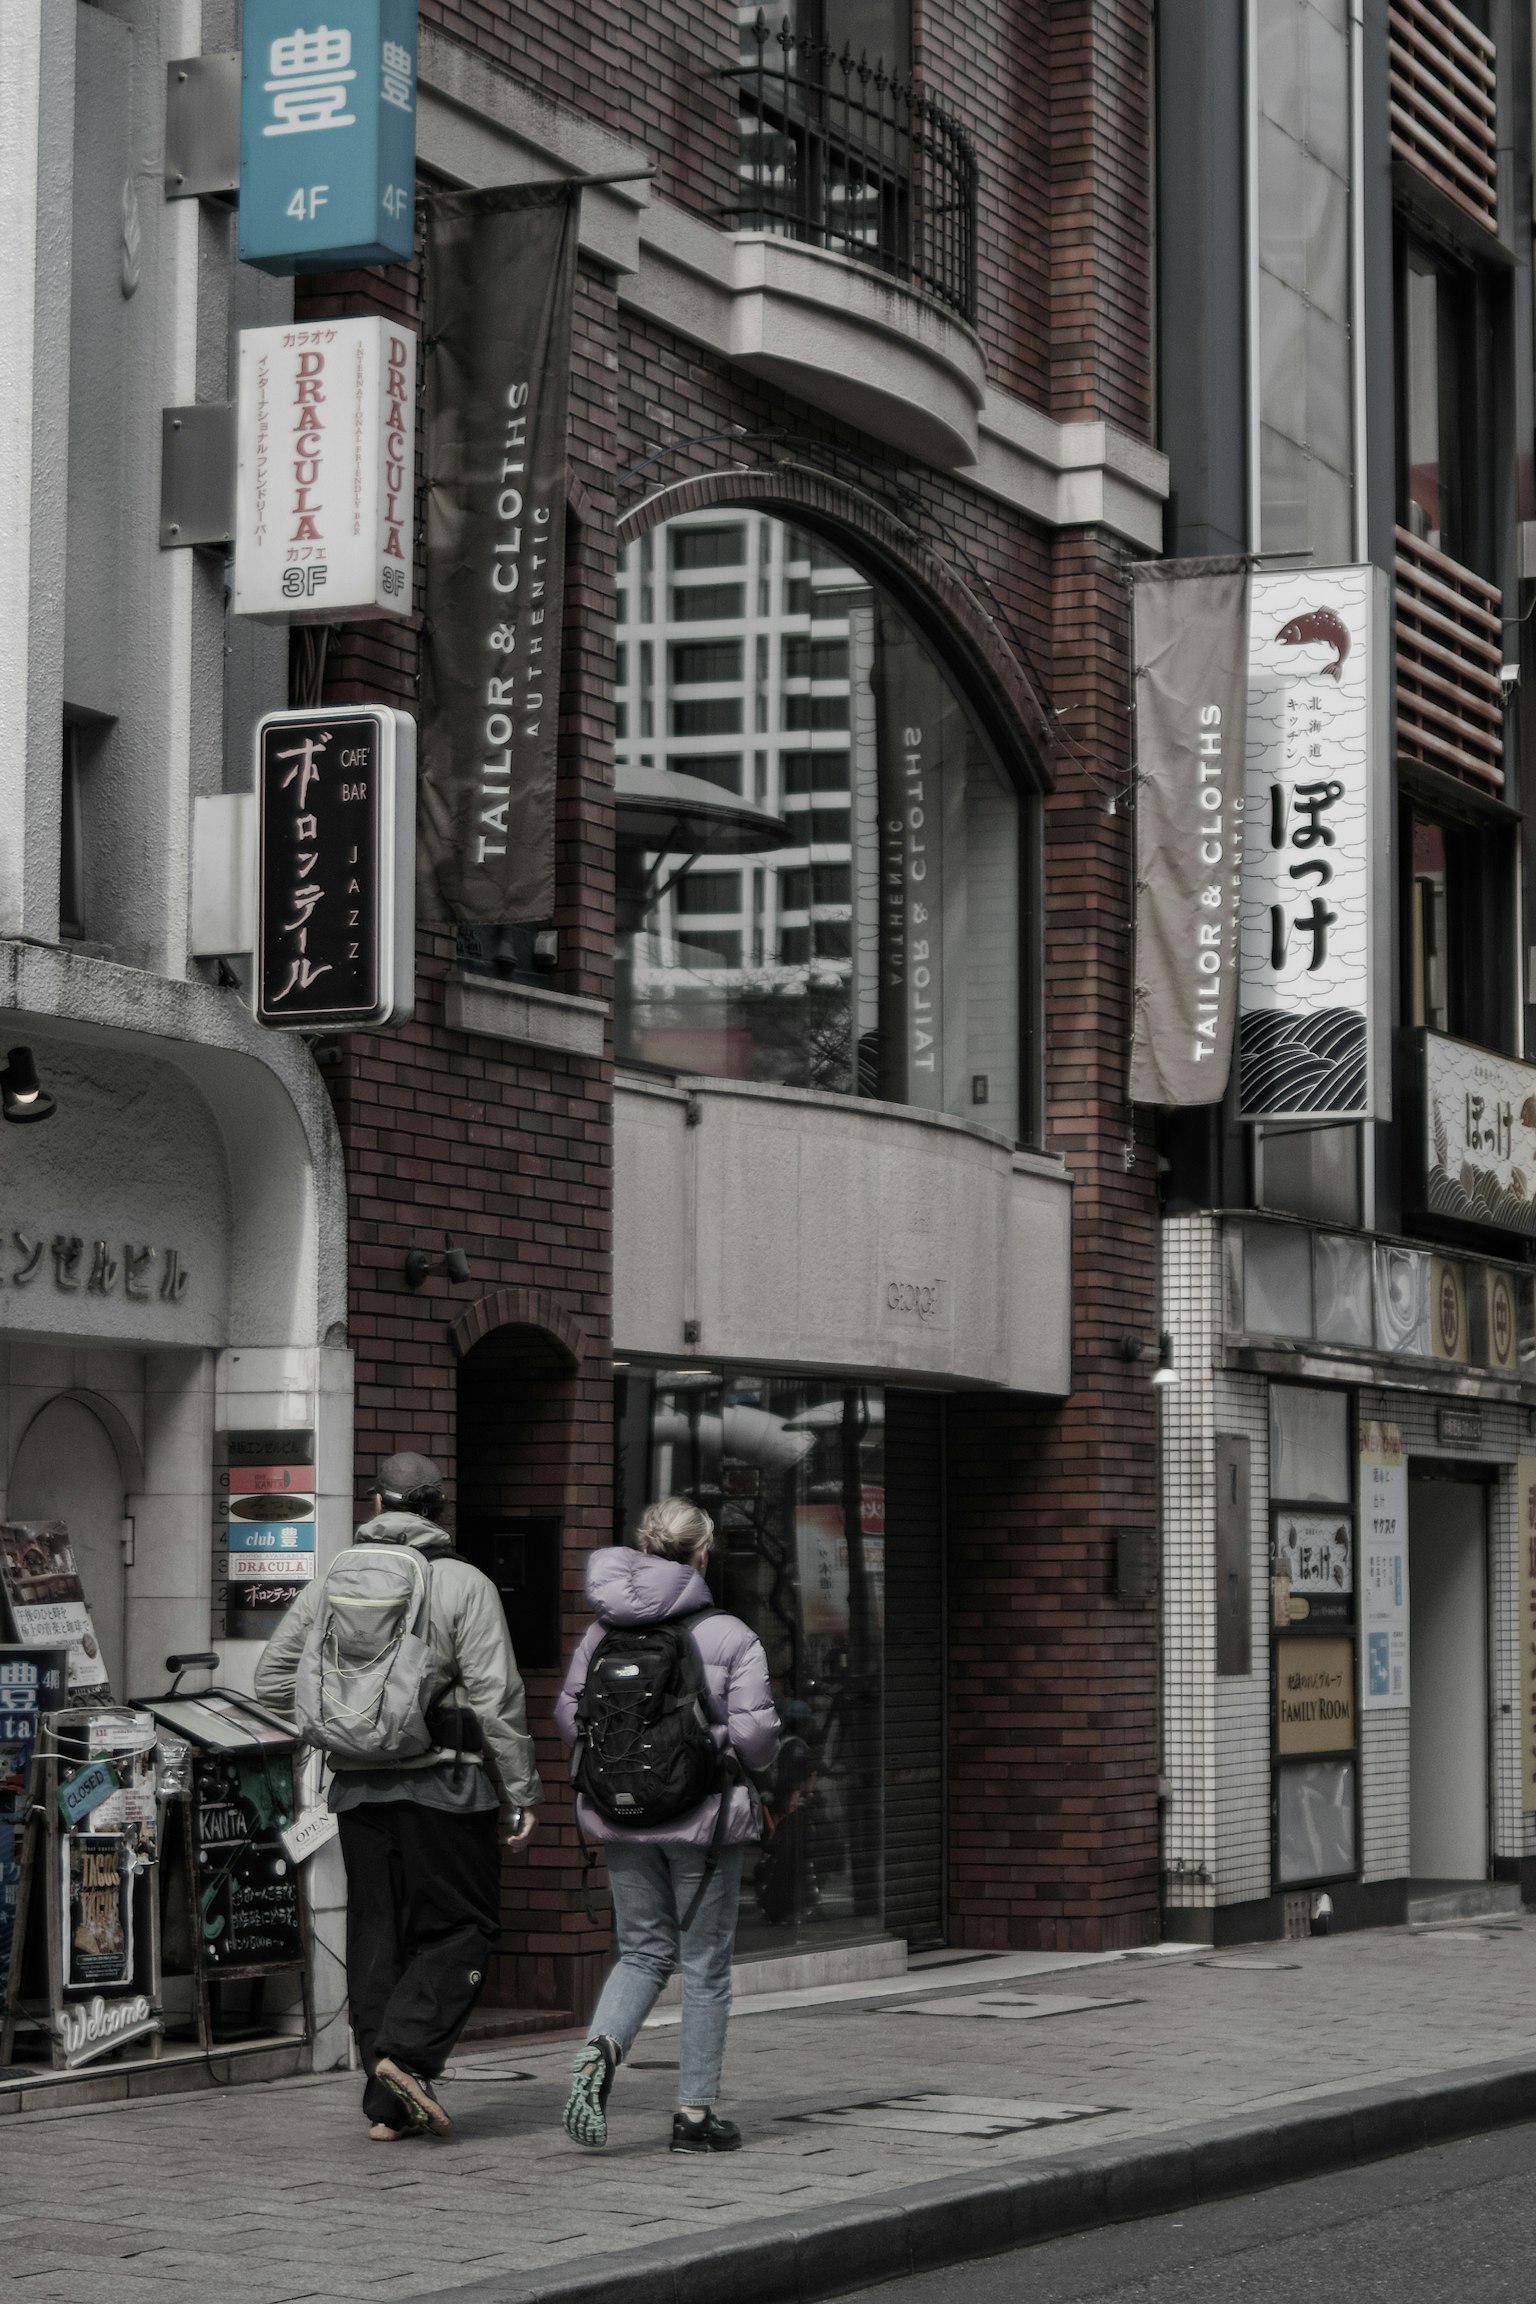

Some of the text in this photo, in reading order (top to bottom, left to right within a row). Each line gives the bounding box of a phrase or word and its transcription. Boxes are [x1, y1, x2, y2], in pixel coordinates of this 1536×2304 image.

[263, 25, 357, 137] 豊
[381, 41, 413, 113] 豊
[286, 185, 329, 221] 4F
[383, 184, 407, 219] 4F
[283, 329, 338, 348] カラオケ
[290, 351, 326, 541] DRACULA
[353, 340, 364, 536] INTERNATIONAL FRIENDLY BAR
[383, 336, 408, 560] DRACULA
[287, 547, 327, 561] カフェ
[282, 565, 328, 598] 3F
[383, 565, 405, 597] 3F
[477, 381, 529, 864] TAILOR & CLOTHS
[526, 507, 550, 737] AUTHENTIC
[1286, 698, 1300, 759] キッチン
[1309, 696, 1323, 758] 北海道
[342, 783, 367, 802] BAR
[273, 731, 334, 1002] ボロンテール
[1194, 704, 1223, 1062] TAILOR & CLOTHS
[1229, 798, 1245, 968] AUTHENTIC
[1270, 780, 1346, 972] ぽっけ
[348, 845, 361, 959] JAZZ
[220, 1472, 230, 1487] 6
[219, 1502, 229, 1516] 5
[219, 1532, 227, 1545] 4
[246, 1527, 298, 1547] club 豊
[218, 1559, 228, 1574] 3
[238, 1562, 306, 1572] DRACULA
[218, 1587, 229, 1602] 2
[244, 1584, 303, 1608] ボロンテール
[1281, 1698, 1350, 1722] FAMILY ROOM
[66, 1770, 105, 1809] CLOSED
[201, 1808, 248, 1841] KANTA
[295, 1813, 330, 1844] OPEN
[82, 1854, 121, 1887] TACOS
[59, 1997, 149, 2052] Welcome
